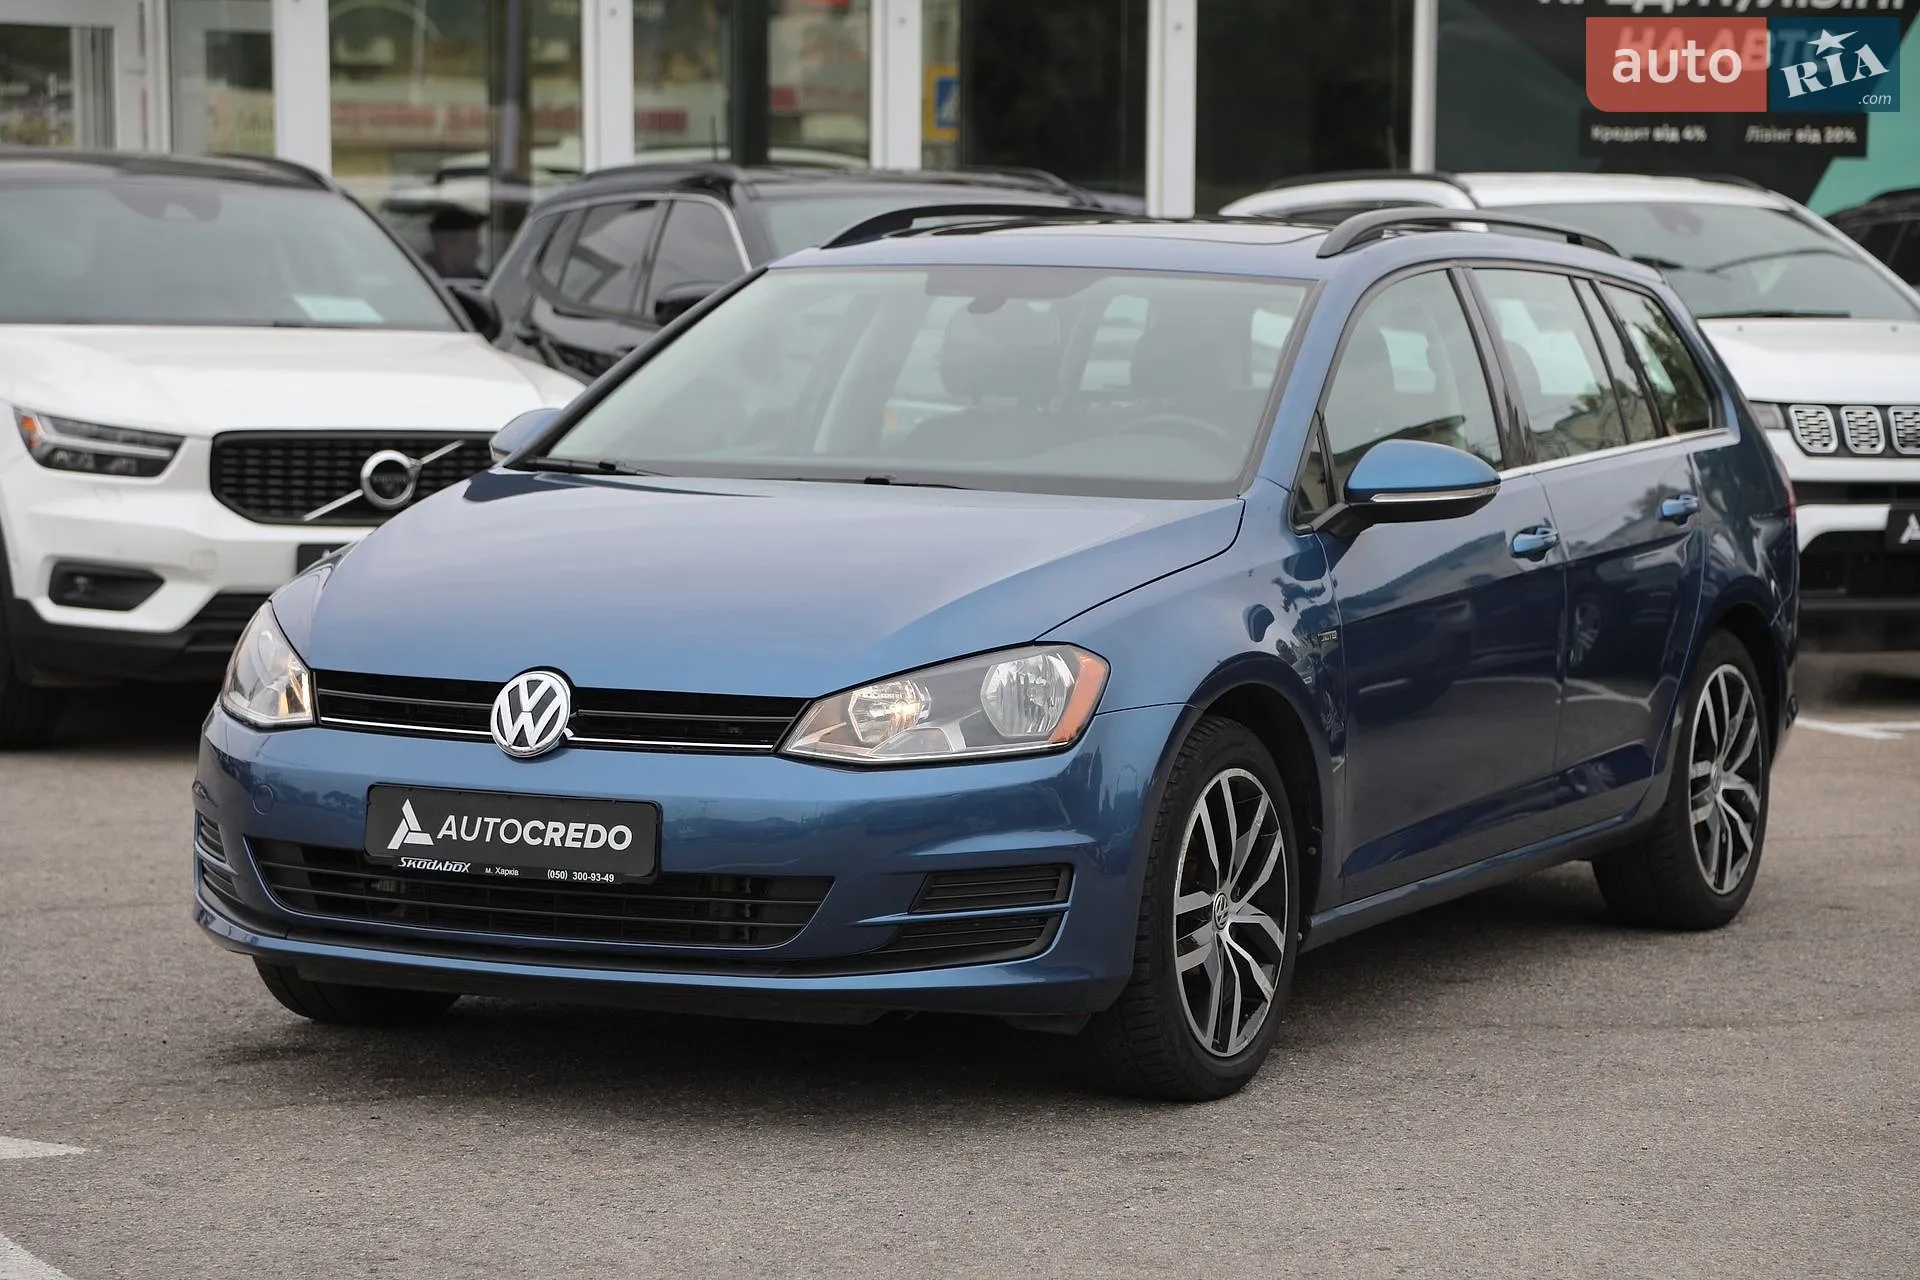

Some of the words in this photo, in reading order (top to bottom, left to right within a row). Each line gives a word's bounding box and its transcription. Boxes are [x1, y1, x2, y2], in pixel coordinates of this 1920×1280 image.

[436, 814, 633, 851] AUTOCREDO
[494, 866, 520, 877] Харків
[547, 868, 569, 881] (050)
[572, 870, 615, 884] 300-93-49
